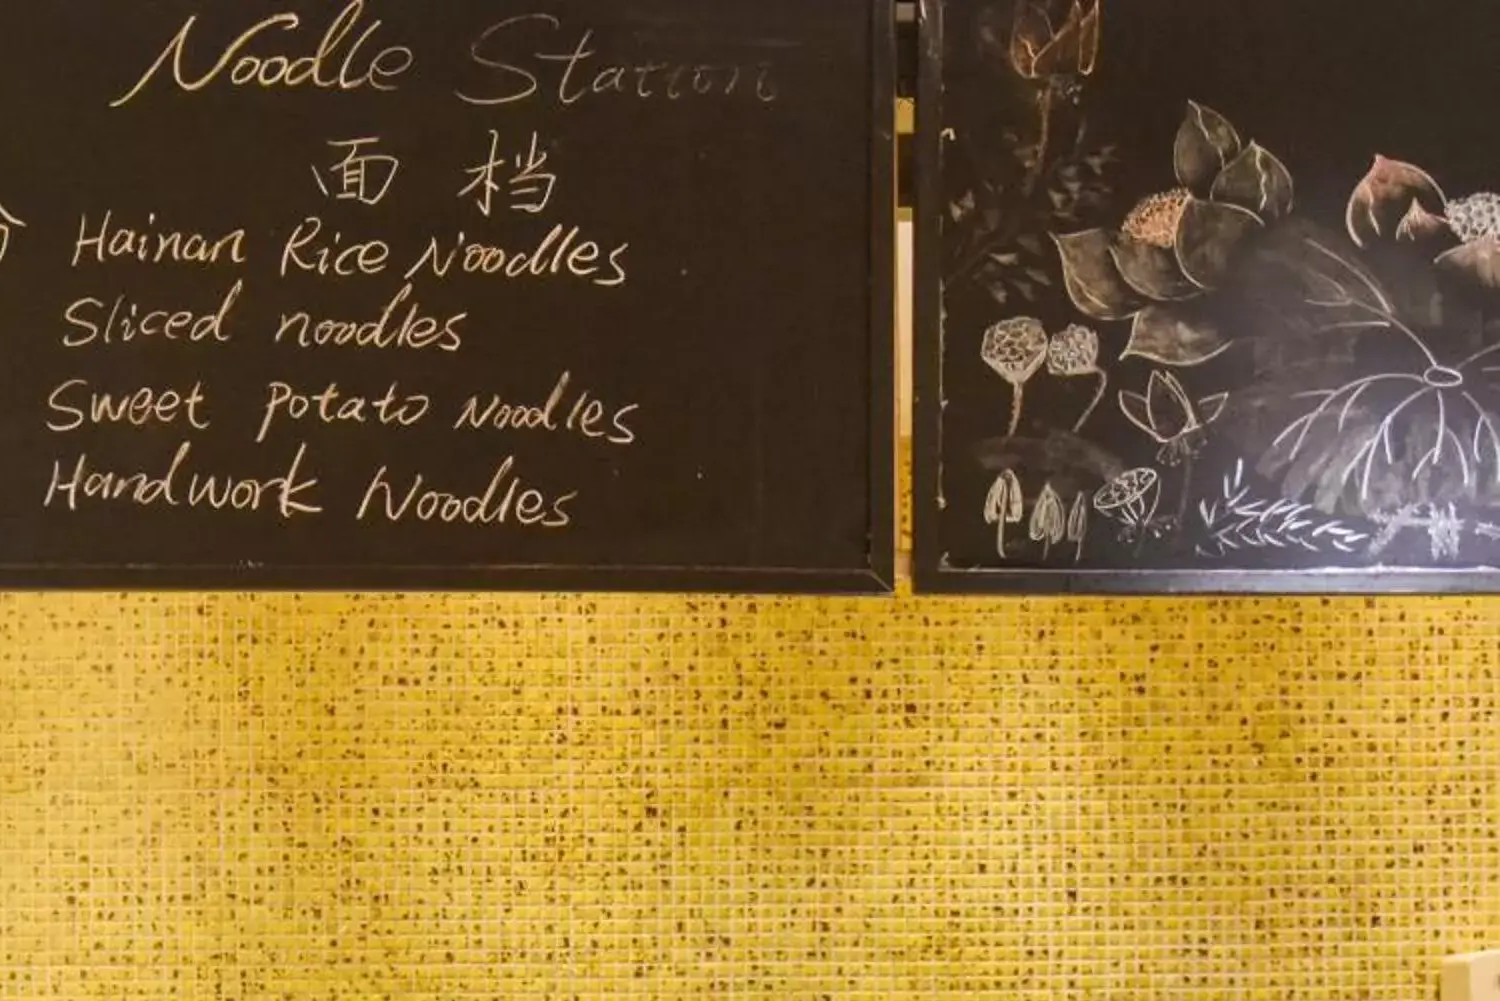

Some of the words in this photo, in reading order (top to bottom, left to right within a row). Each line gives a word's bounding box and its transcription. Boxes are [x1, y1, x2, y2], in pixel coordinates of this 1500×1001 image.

[108, 0, 414, 107] Noodle
[310, 129, 557, 217] 面档
[70, 210, 246, 267] Hainan
[280, 217, 390, 276] Rice
[403, 223, 630, 285] Noodles
[62, 279, 244, 347] Sliced
[274, 283, 468, 351] noodles
[45, 379, 211, 432] Sweet
[452, 370, 639, 443] Noodles
[43, 441, 324, 518] Handwork
[355, 455, 578, 528] Noodles
